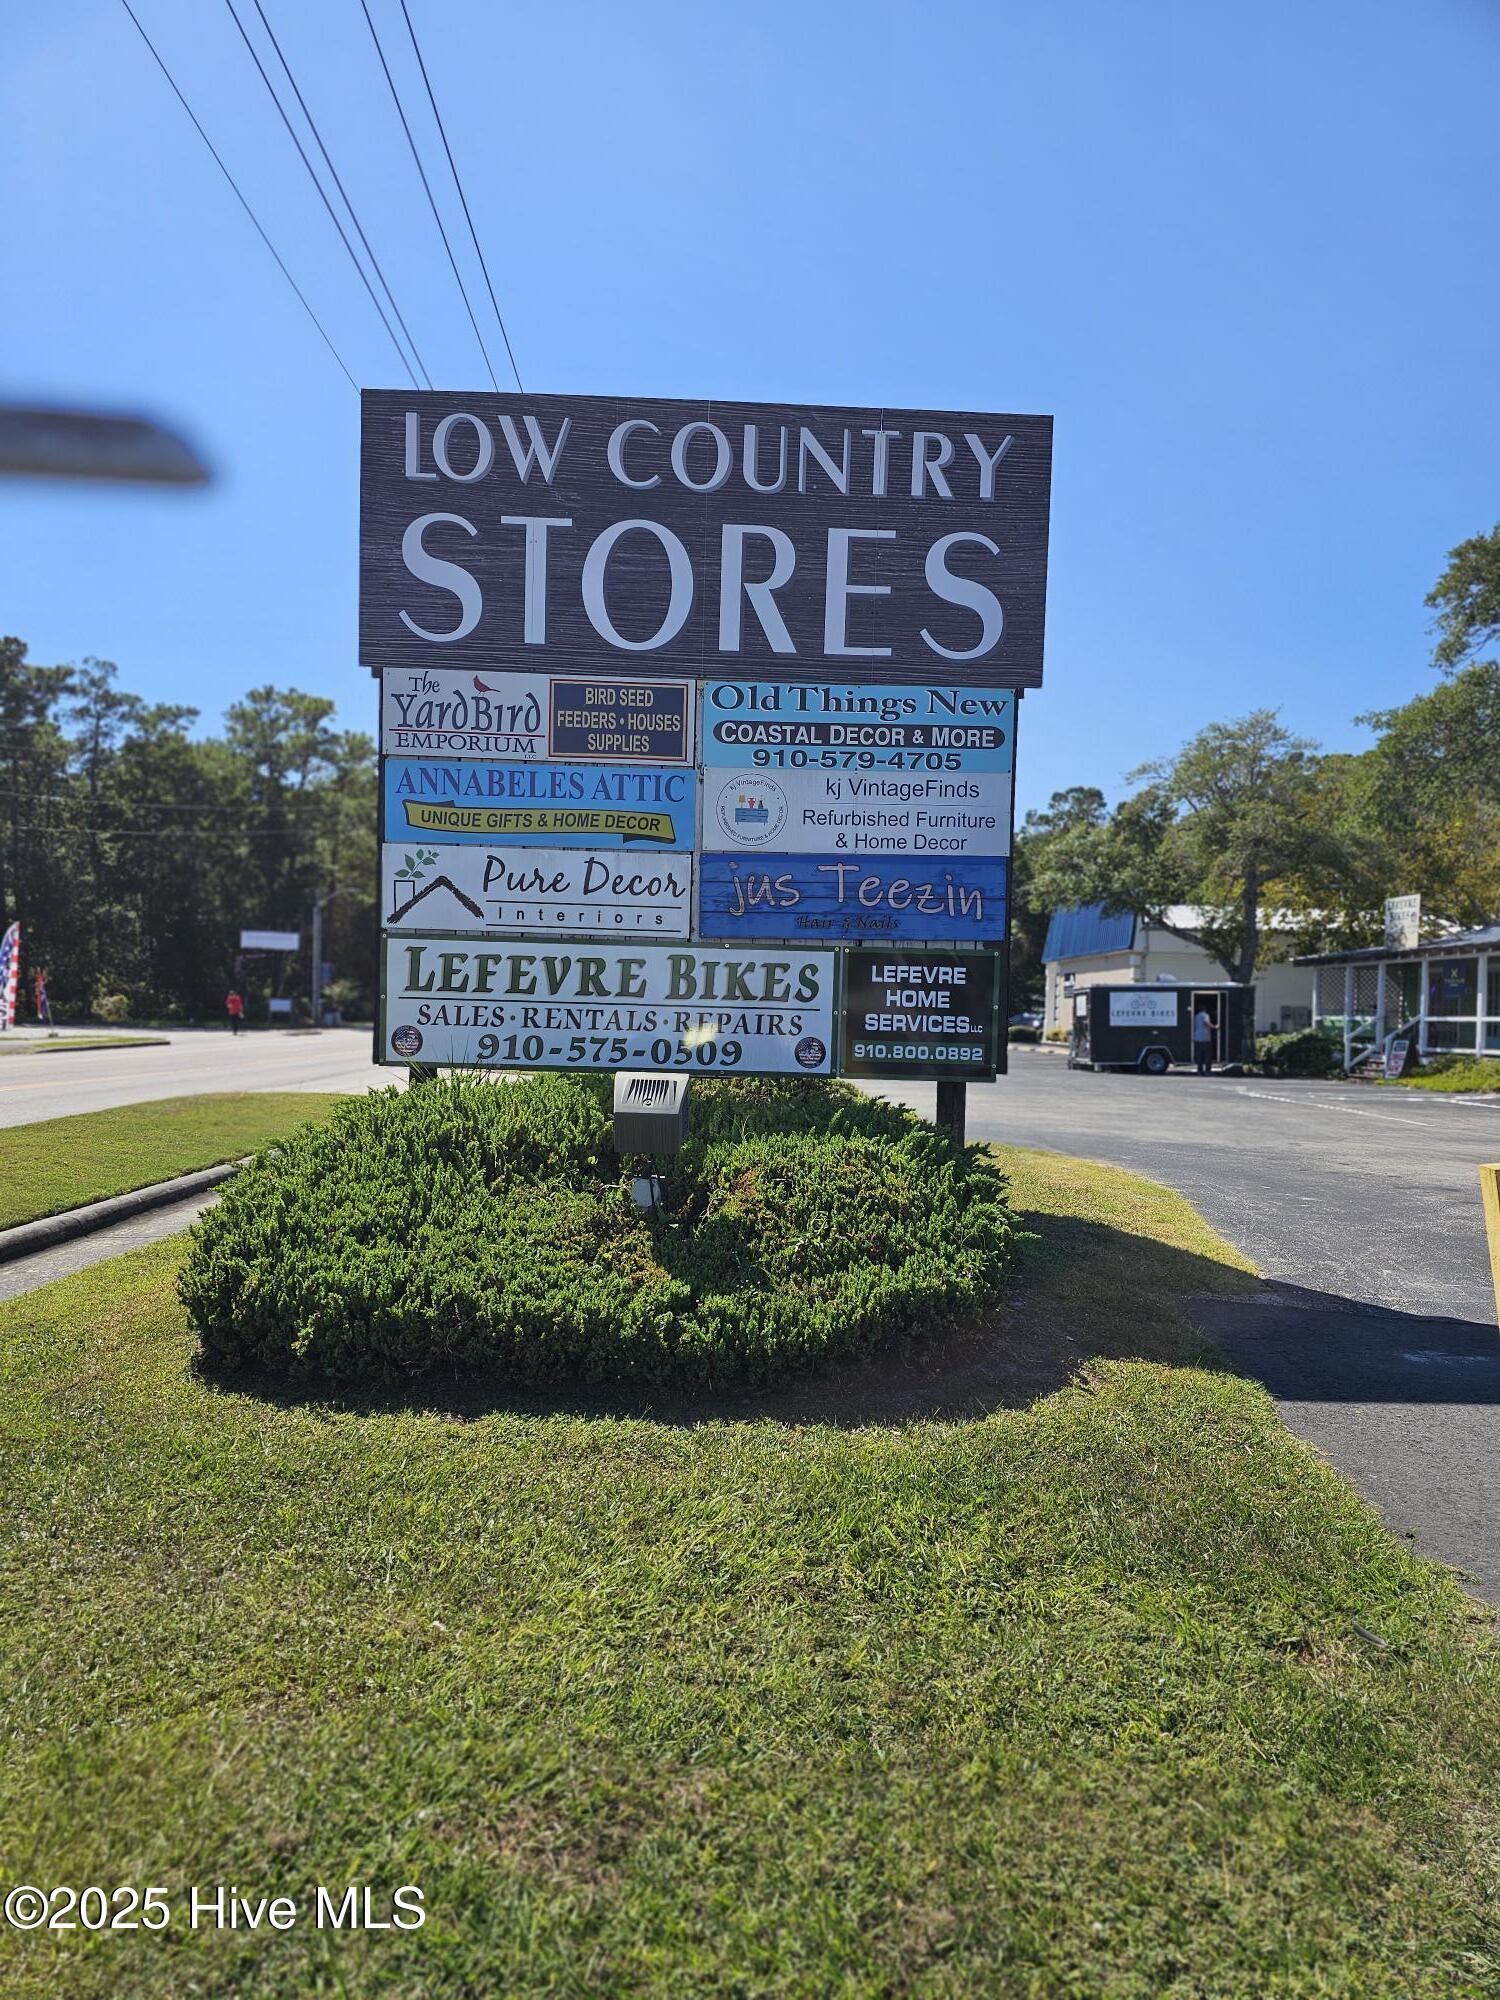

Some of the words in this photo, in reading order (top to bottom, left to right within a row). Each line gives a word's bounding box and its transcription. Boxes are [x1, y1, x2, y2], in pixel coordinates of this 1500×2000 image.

[404, 411, 573, 486] LOW
[607, 419, 1016, 499] COUNTRY
[397, 511, 1005, 661] STORES
[408, 671, 440, 696] The
[585, 687, 616, 706] BIRD
[619, 688, 654, 707] SEED
[710, 684, 782, 711] Old
[788, 686, 917, 722] Things
[926, 689, 1009, 717] New
[391, 688, 541, 733] YardBird
[557, 710, 617, 729] FEEDERS
[628, 713, 681, 732] HOUSES
[395, 732, 537, 753] EMPORIUM
[587, 733, 650, 753] SUPPLIES
[721, 722, 822, 745] COASTAL
[829, 724, 905, 747] DECOR
[912, 729, 924, 745] &
[931, 726, 995, 749] MORE
[752, 748, 962, 771] 910-579-4705
[395, 766, 584, 801] ANNABELES
[591, 772, 686, 803] ATTIC
[825, 777, 842, 799] kj
[848, 778, 980, 801] VintageFinds
[421, 809, 480, 828] UNIQUE
[486, 810, 532, 828] GIFTS
[539, 813, 548, 828] &
[553, 812, 600, 829] HOME
[604, 814, 661, 832] DECOR
[802, 810, 910, 828] Refurbished
[916, 811, 996, 829] Furniture
[835, 832, 848, 849] &
[855, 833, 907, 850] Home
[914, 833, 968, 851] Decor
[483, 854, 570, 893] Pure
[583, 856, 686, 898] Decor
[728, 861, 802, 917] jus
[817, 862, 984, 921] Teezin
[498, 906, 664, 925] Interiors
[404, 945, 647, 999] LEFEVRE
[664, 953, 820, 1003] BIKES
[871, 965, 967, 985] LEFEVRE
[886, 989, 951, 1009] HOME
[416, 1003, 506, 1028] SALES
[521, 1006, 659, 1032] RENTALS
[672, 1011, 803, 1036] REPAIRS
[864, 1013, 971, 1034] SERVICES
[970, 1024, 984, 1034] LLC
[477, 1033, 743, 1067] 910-575-0509
[853, 1043, 984, 1062] 910.800.0892
